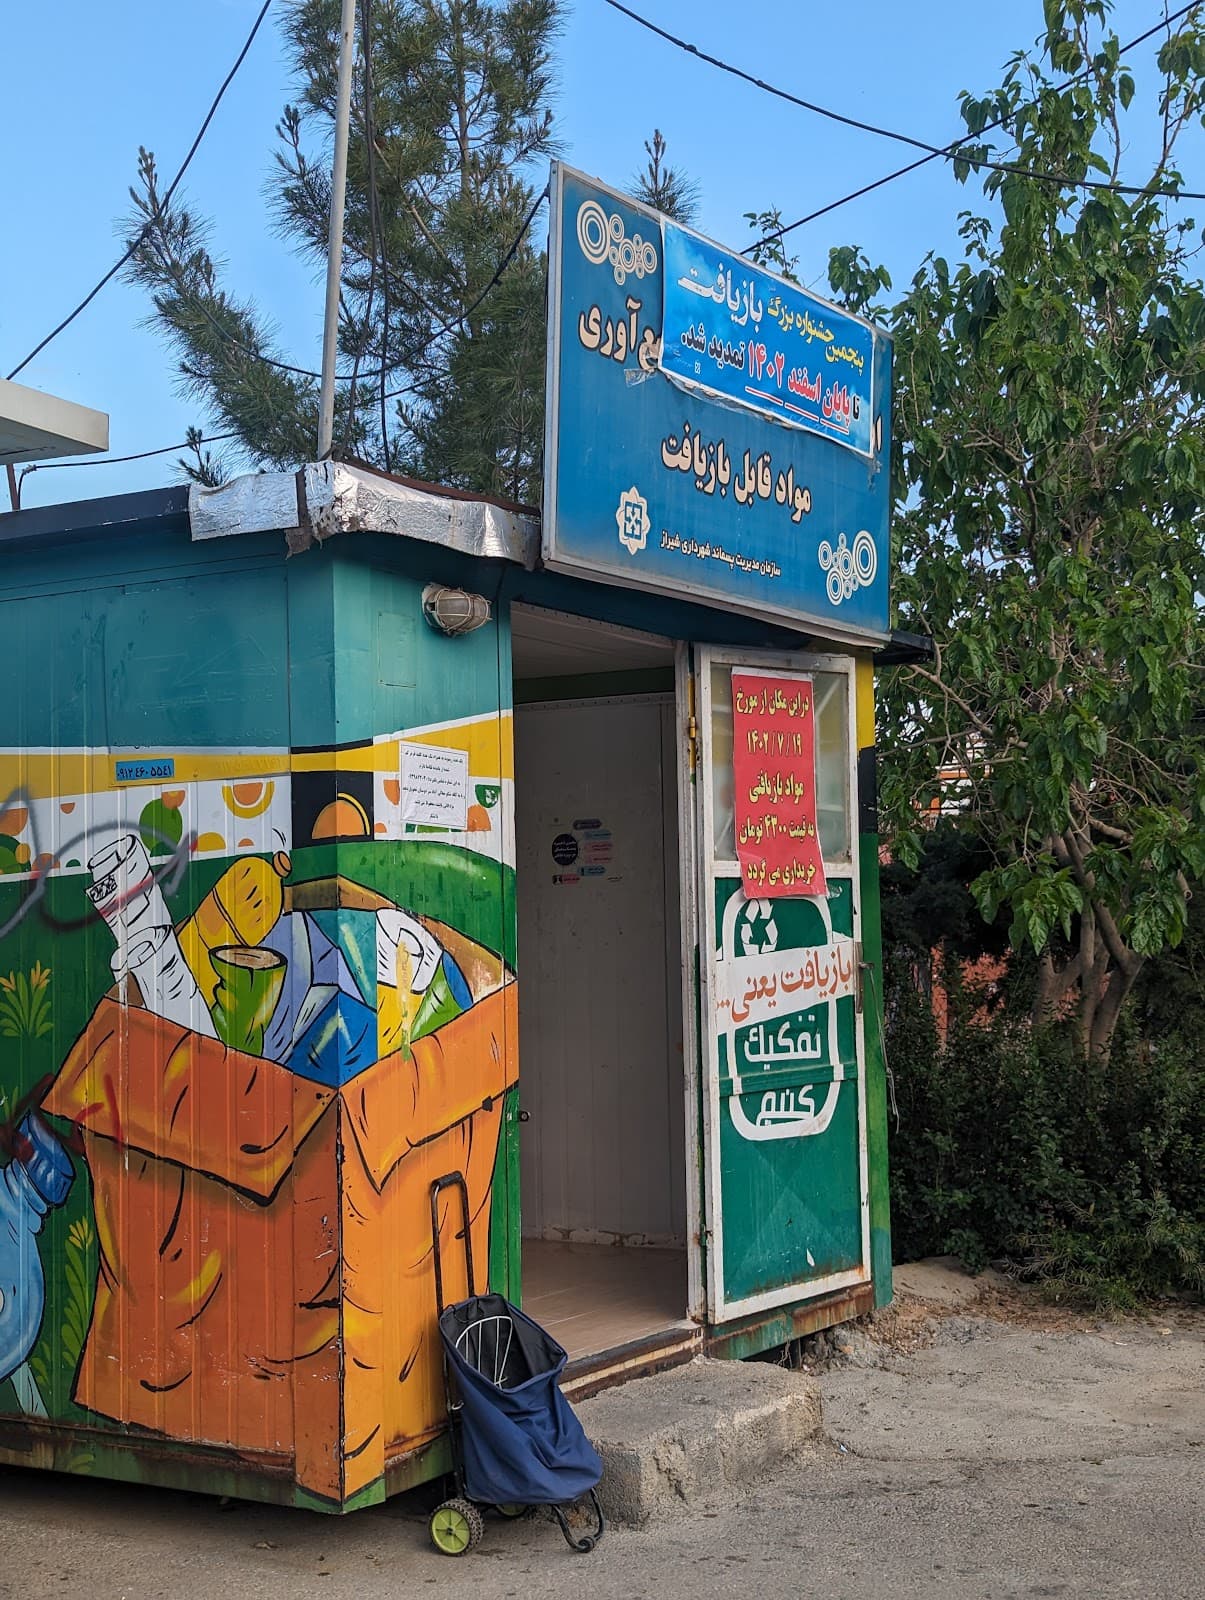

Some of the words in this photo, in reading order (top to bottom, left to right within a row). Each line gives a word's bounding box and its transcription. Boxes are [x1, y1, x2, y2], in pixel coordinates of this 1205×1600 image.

[678, 262, 763, 334] بازیافت
[577, 294, 643, 364] آوری
[767, 296, 794, 332] بزرگ
[707, 334, 746, 370] تمدید
[747, 339, 785, 389] ۱۴۰۲
[825, 345, 865, 376] پنجمین
[787, 365, 822, 404] اسفند
[822, 380, 851, 428] پایان
[851, 393, 861, 421] تا
[660, 419, 732, 500] بازیافت
[733, 448, 773, 509] قابل
[774, 463, 813, 524] مواد
[660, 528, 681, 551] شیراز
[681, 538, 711, 559] شهرداری
[711, 546, 735, 570] پسماند
[735, 552, 760, 574] مدیریت
[760, 559, 782, 578] سازمان
[736, 686, 758, 714] مورخ
[760, 687, 768, 715] از
[769, 688, 788, 715] مکان
[749, 768, 783, 804] بازیافتی
[785, 773, 804, 804] مواد
[739, 815, 763, 845] تومان
[788, 815, 807, 843] قیمت
[807, 822, 815, 842] به
[747, 857, 767, 887] گردد
[768, 866, 781, 886] می
[782, 856, 816, 885] خریداری
[780, 944, 852, 999] بازیافت
[743, 1014, 822, 1071] تفکیک
[755, 1083, 815, 1127] کنیم
